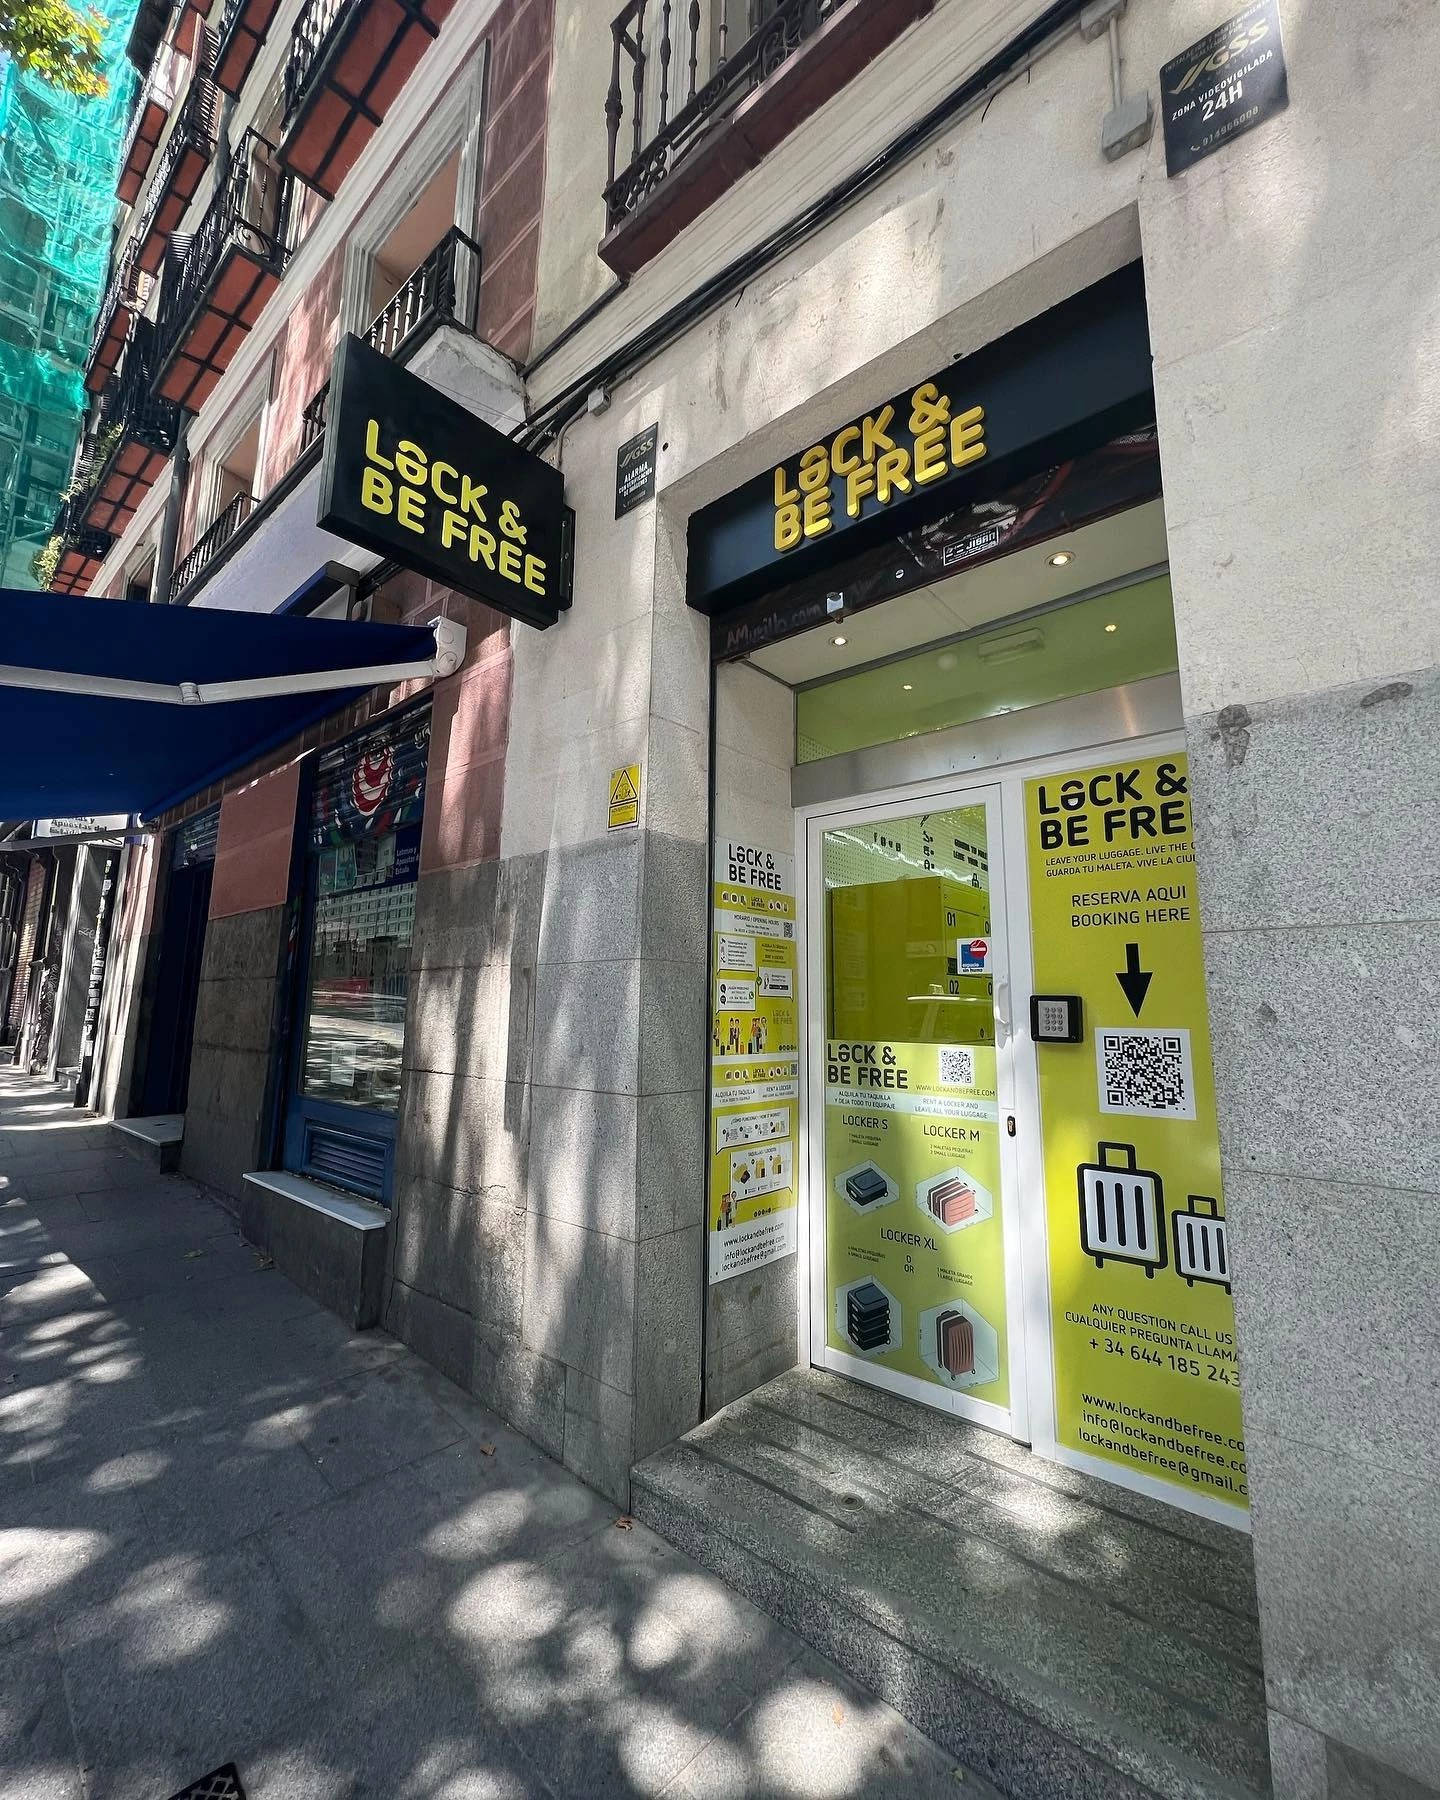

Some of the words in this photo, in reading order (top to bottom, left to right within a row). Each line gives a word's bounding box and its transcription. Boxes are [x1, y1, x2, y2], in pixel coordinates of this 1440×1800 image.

[1172, 101, 1196, 121] ZONA
[1199, 50, 1273, 102] VIDEOVIGILADA
[1202, 80, 1243, 121] 24H
[774, 405, 896, 508] LOCK
[908, 382, 950, 436] &
[366, 419, 487, 522] LOCK
[498, 500, 526, 544] &
[624, 462, 648, 484] ALARMA
[774, 486, 832, 552] BE
[847, 406, 987, 518] FREE
[362, 466, 426, 534] BE
[442, 510, 546, 595] FREE
[1038, 769, 1143, 815] LOCK
[1155, 763, 1188, 797] &
[51, 820, 92, 830] Apuestas
[1040, 814, 1089, 850] BE
[1103, 800, 1193, 842] FRE
[729, 843, 762, 868] LOCK
[766, 853, 775, 870] &
[1046, 855, 1071, 866] LEAVE
[1073, 853, 1097, 863] YOUR
[1099, 848, 1143, 860] LUGGAGE.
[1146, 844, 1166, 854] LIVE
[1168, 842, 1187, 852] THE
[1047, 866, 1080, 877] GUARDA
[1097, 861, 1134, 872] MALETA.
[1137, 858, 1158, 868] VIVE
[1161, 857, 1173, 865] LA
[1176, 854, 1196, 863] CIU
[729, 864, 746, 883] BE
[751, 869, 781, 890] FREE
[1072, 890, 1141, 907] RESERVA
[1146, 885, 1186, 901] AQUI
[947, 912, 956, 927] 01
[1072, 911, 1140, 927] BOOKING
[1146, 907, 1190, 923] HERE
[950, 980, 959, 994] 02
[828, 1043, 876, 1065] LOCK
[882, 1044, 896, 1066] &
[828, 1065, 851, 1084] BE
[858, 1067, 908, 1089] FREE
[866, 1092, 891, 1101] TAQUILLA
[916, 1084, 995, 1097] WWW.LOCKANDBEFREE.COM
[872, 1101, 895, 1110] EQUIPAJE
[944, 1100, 965, 1108] LOCKER
[961, 1110, 988, 1119] LUGGAGE
[842, 1114, 879, 1128] LOCKER
[882, 1119, 888, 1130] S
[923, 1124, 966, 1140] LOCKER
[970, 1130, 980, 1142] M
[724, 1222, 784, 1248] www.lockandbefree.com
[881, 1228, 920, 1247] LOCKER
[924, 1237, 938, 1250] XL
[721, 1243, 786, 1272] lockandbefree@gmail.com
[724, 1235, 785, 1260] info@lockandbefree.com
[904, 1264, 914, 1274] OR
[1065, 1312, 1126, 1335] CUALQUIER
[1130, 1328, 1193, 1352] PREGUNTA
[1092, 1303, 1114, 1317] ANY
[1117, 1309, 1176, 1332] QUESTION
[1180, 1323, 1211, 1340] CALL
[1216, 1331, 1232, 1344] US
[1089, 1338, 1099, 1349] +
[1104, 1338, 1125, 1356] 34
[1130, 1346, 1163, 1367] 644
[1168, 1355, 1200, 1377] 185
[1207, 1365, 1240, 1387] 243
[1082, 1393, 1245, 1452] www.lockandbefree.co
[1083, 1410, 1247, 1474] info@lockandbefree.co
[1078, 1427, 1247, 1496] lockandbefree@gmail.c
